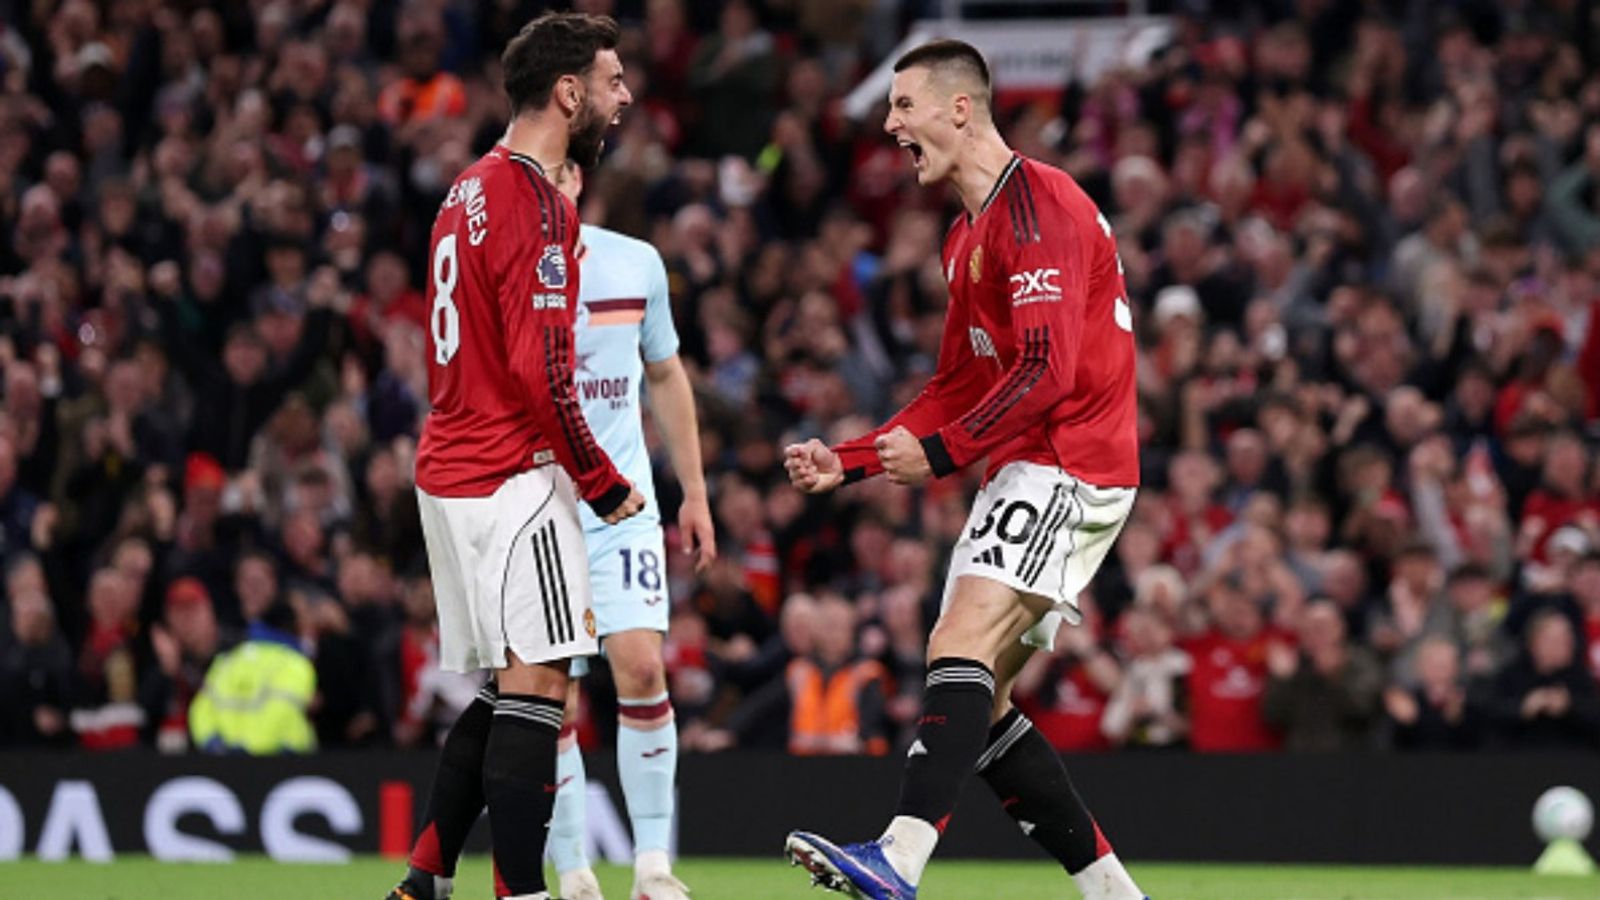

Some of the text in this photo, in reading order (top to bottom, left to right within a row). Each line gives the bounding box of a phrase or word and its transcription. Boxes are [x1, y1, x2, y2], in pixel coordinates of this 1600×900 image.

[431, 232, 460, 366] 8
[1009, 268, 1062, 300] DXC
[618, 547, 662, 591] 18
